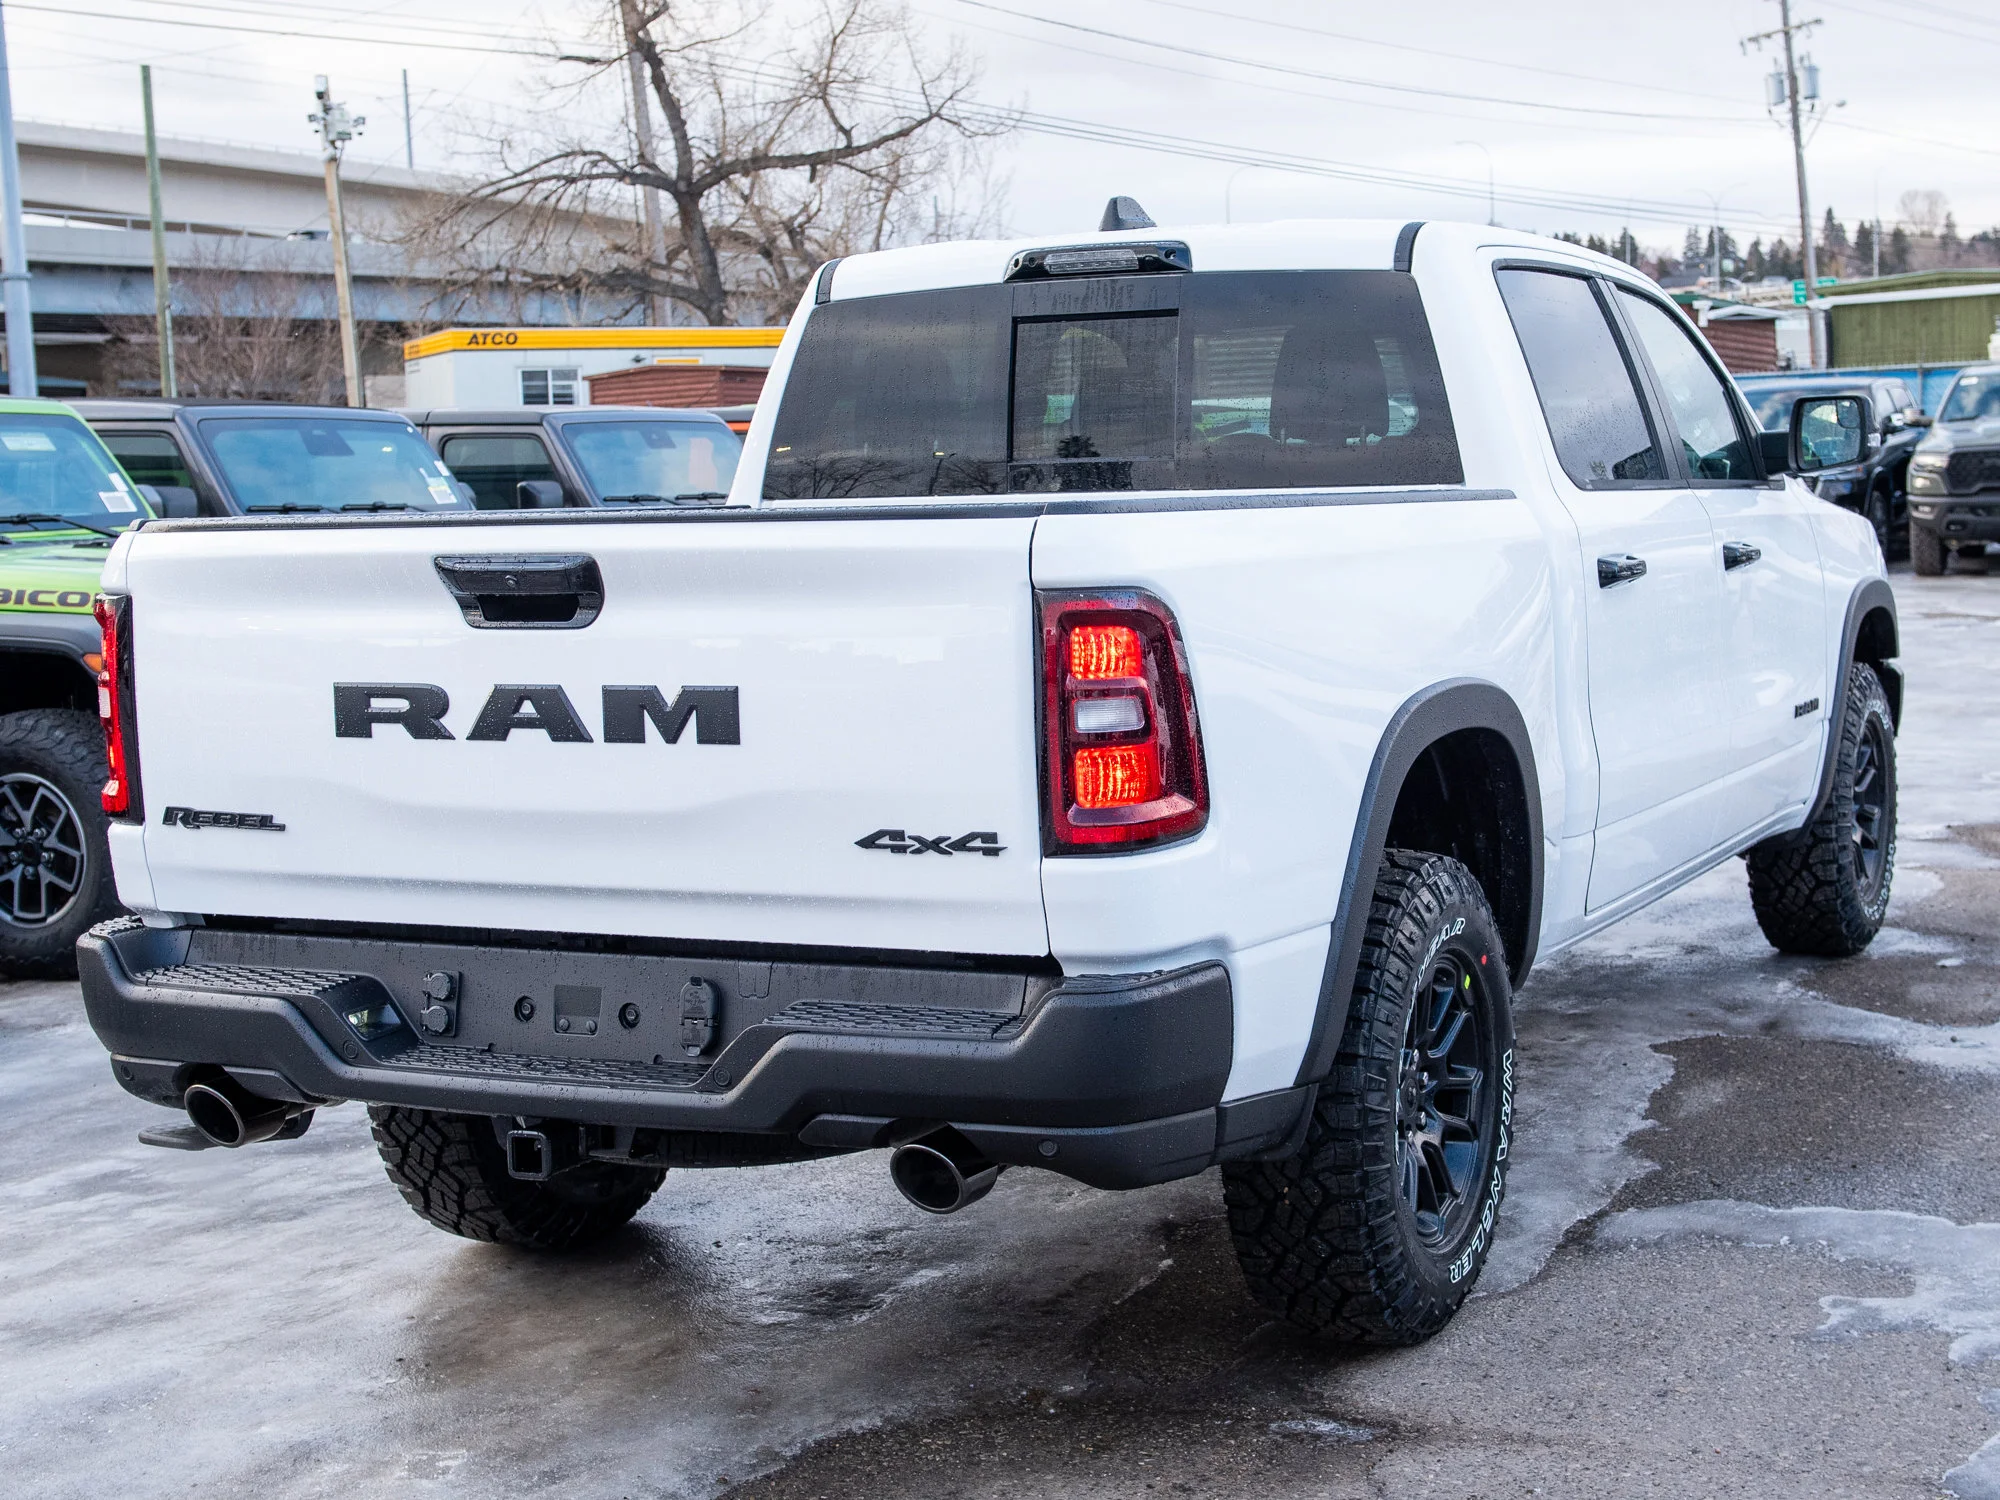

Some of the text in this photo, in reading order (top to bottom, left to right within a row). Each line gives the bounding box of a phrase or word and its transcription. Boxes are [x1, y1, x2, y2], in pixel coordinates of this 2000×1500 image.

[467, 332, 519, 346] ATCO
[333, 682, 741, 745] RAM
[162, 806, 286, 831] REBEL
[854, 829, 1008, 856] 4x4
[1450, 1048, 1513, 1284] WRANGLER
